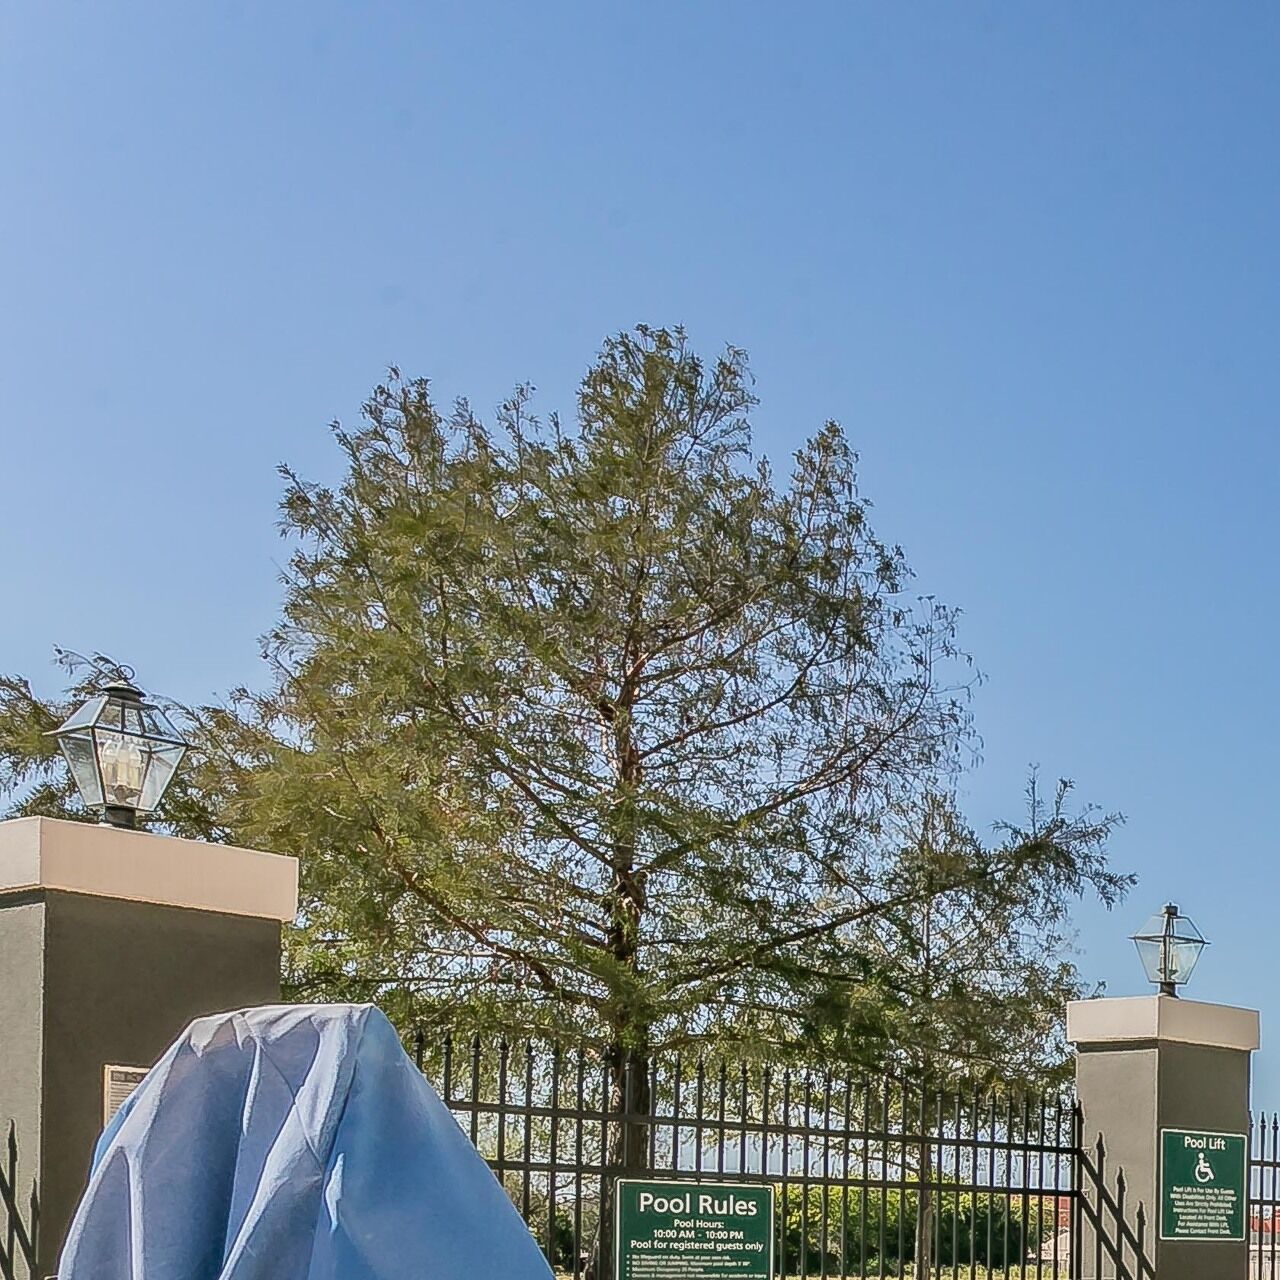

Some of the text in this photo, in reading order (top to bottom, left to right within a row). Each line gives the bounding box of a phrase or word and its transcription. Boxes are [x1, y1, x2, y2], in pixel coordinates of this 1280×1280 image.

[1184, 1136, 1226, 1150] Pool Lift
[640, 1193, 757, 1215] Pool Rules
[674, 1219, 724, 1228] Pool Hours:
[653, 1230, 677, 1238] 10:00
[678, 1230, 695, 1238] AM
[705, 1231, 728, 1239] 10:00
[730, 1231, 744, 1239] PM
[631, 1240, 763, 1252] Pool for registered guests only
